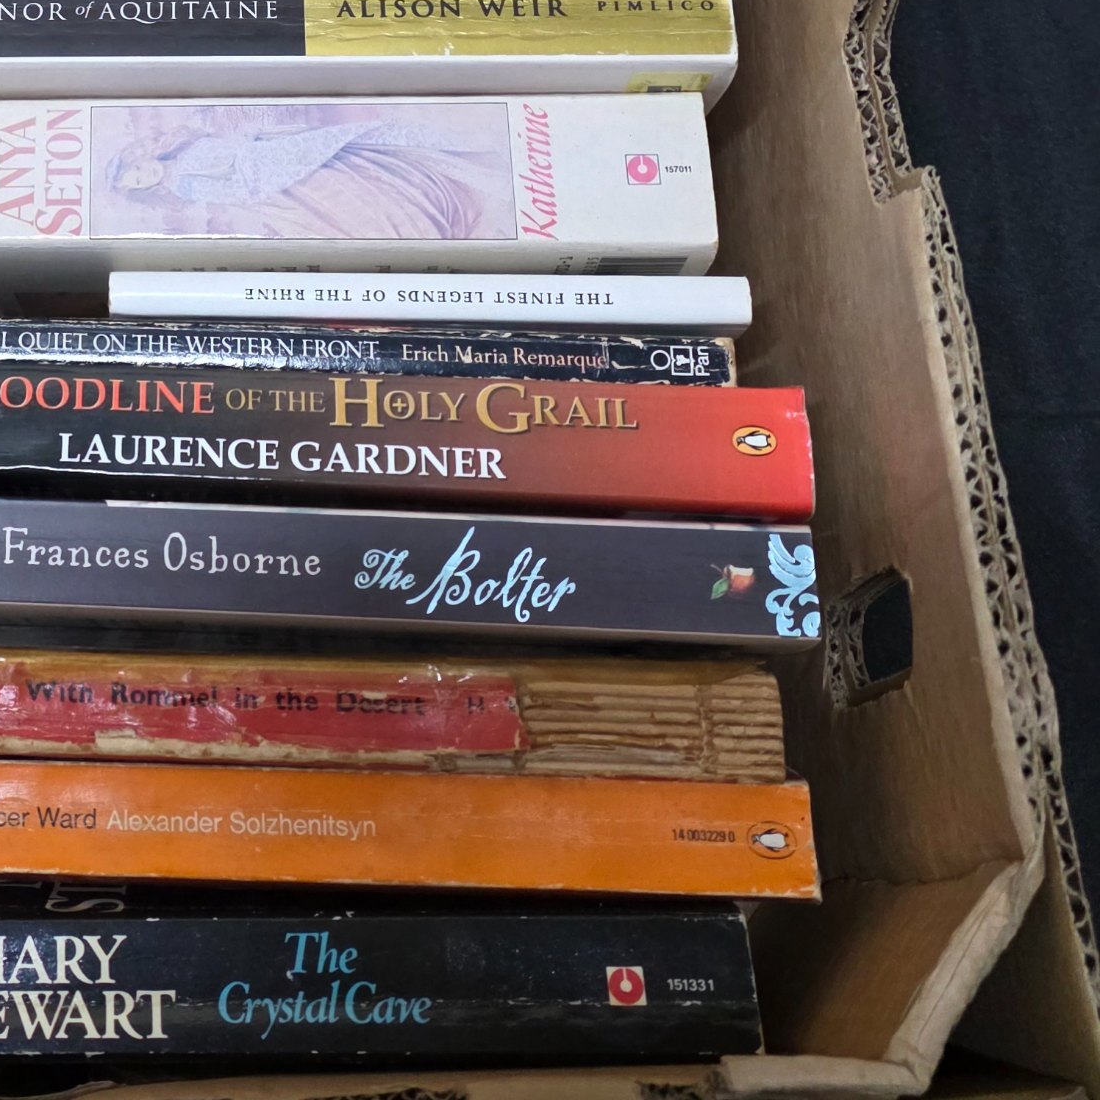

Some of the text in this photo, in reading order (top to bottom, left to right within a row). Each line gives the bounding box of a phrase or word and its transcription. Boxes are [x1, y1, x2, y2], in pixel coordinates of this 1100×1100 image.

[75, 0, 97, 19] of
[99, 0, 279, 25] AQUITAINE
[336, 0, 461, 18] ALISON
[597, 0, 715, 12] PIMLICO
[34, 108, 83, 237] SETON
[517, 102, 559, 241] Katherine
[664, 164, 693, 174] 157011
[244, 287, 614, 306] THE FINEST LEGENDS OF THE RHINE
[401, 343, 608, 369] Erich Maria Remarque
[695, 346, 711, 377] Pan
[59, 432, 507, 480] LAURENCE GARDNER
[1, 526, 322, 577] Frances Osborne
[354, 526, 577, 624] The Bolter
[37, 806, 97, 830] Ward
[106, 808, 223, 833] Alexander
[229, 812, 377, 841] Solzhenitsyn
[285, 931, 358, 976] The
[666, 978, 715, 992] 151331
[218, 979, 433, 1040] Crystal Cave
